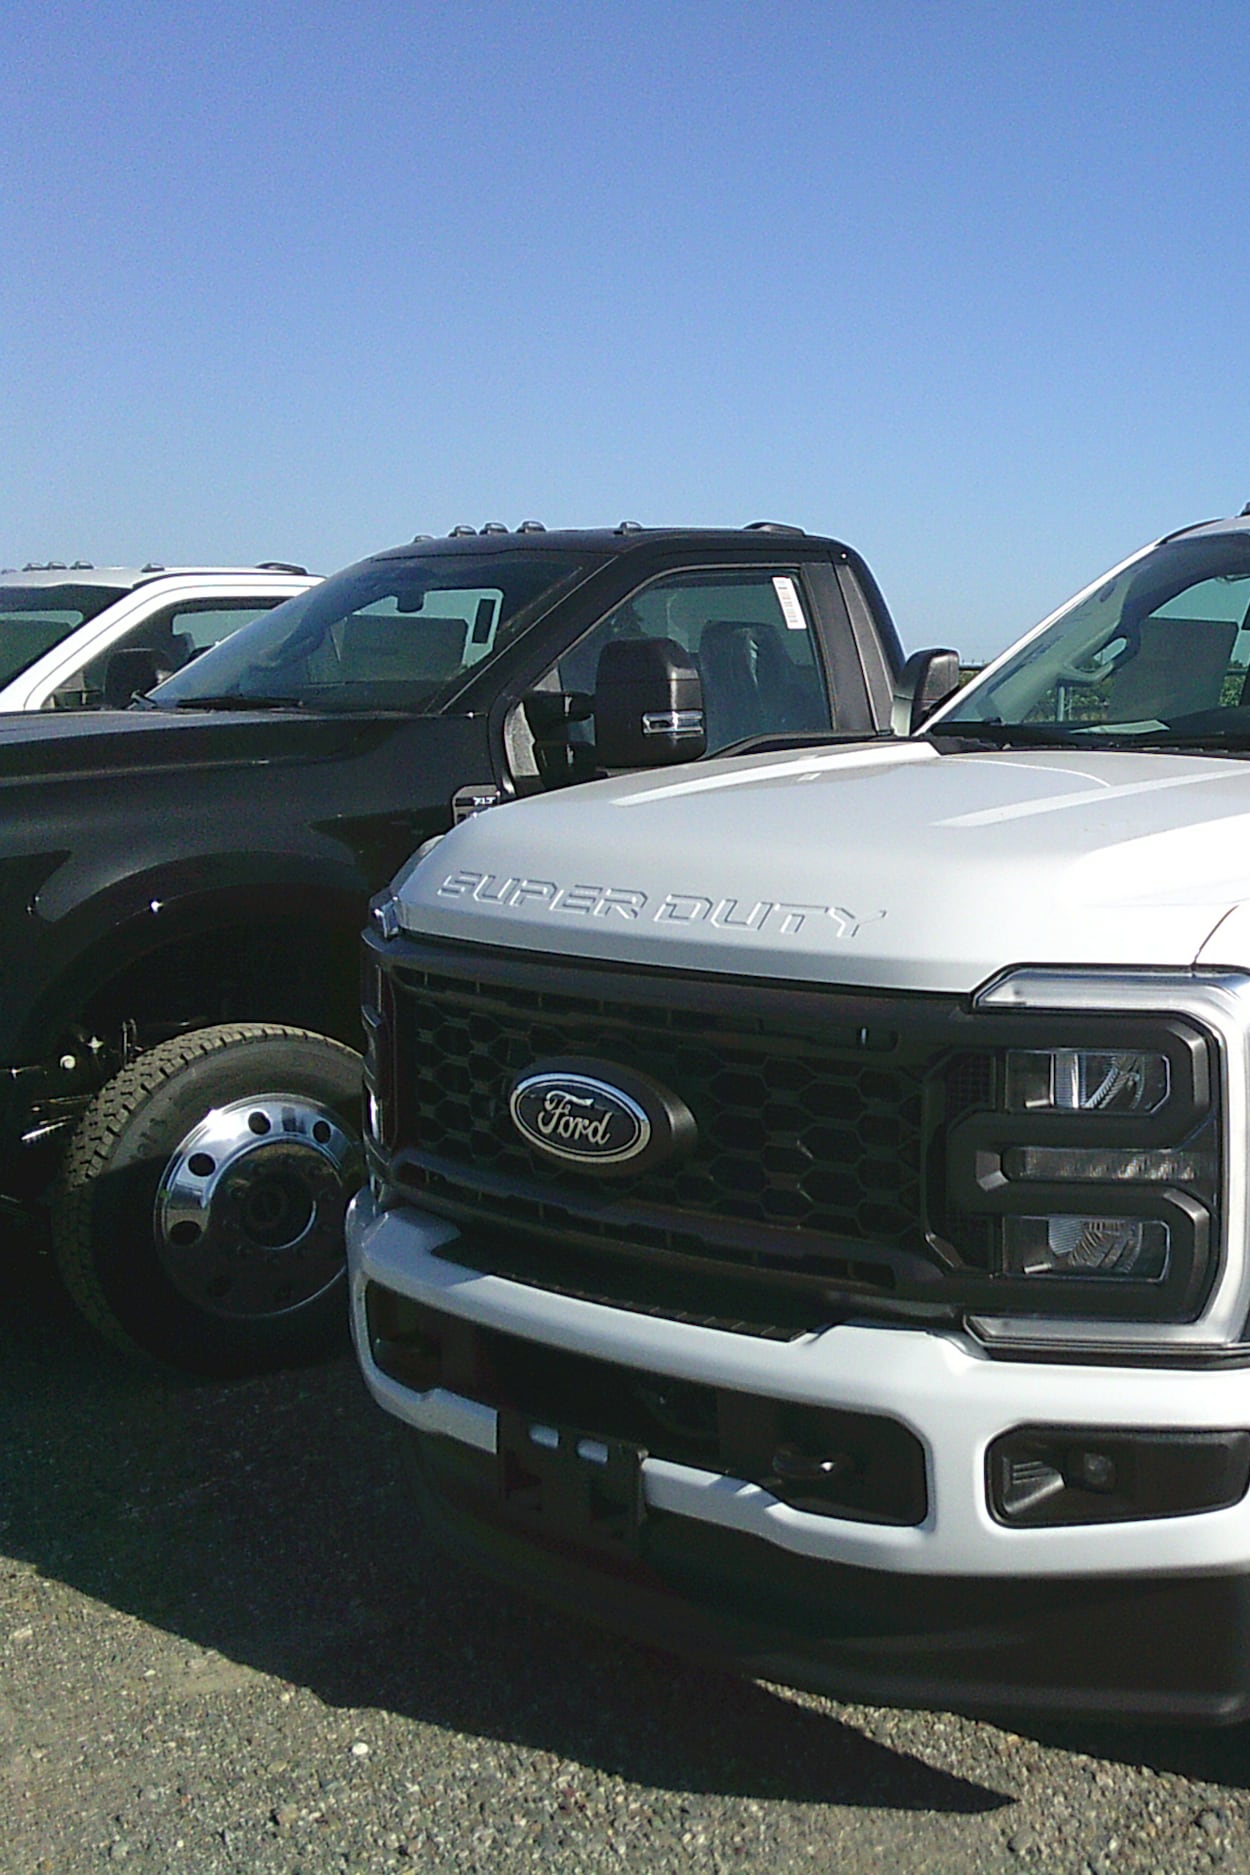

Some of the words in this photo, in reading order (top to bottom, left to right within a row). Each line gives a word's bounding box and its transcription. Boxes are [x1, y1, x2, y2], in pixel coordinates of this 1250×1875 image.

[437, 870, 648, 920] SUPER
[652, 892, 887, 939] DUTY
[537, 1090, 614, 1145] Ford
